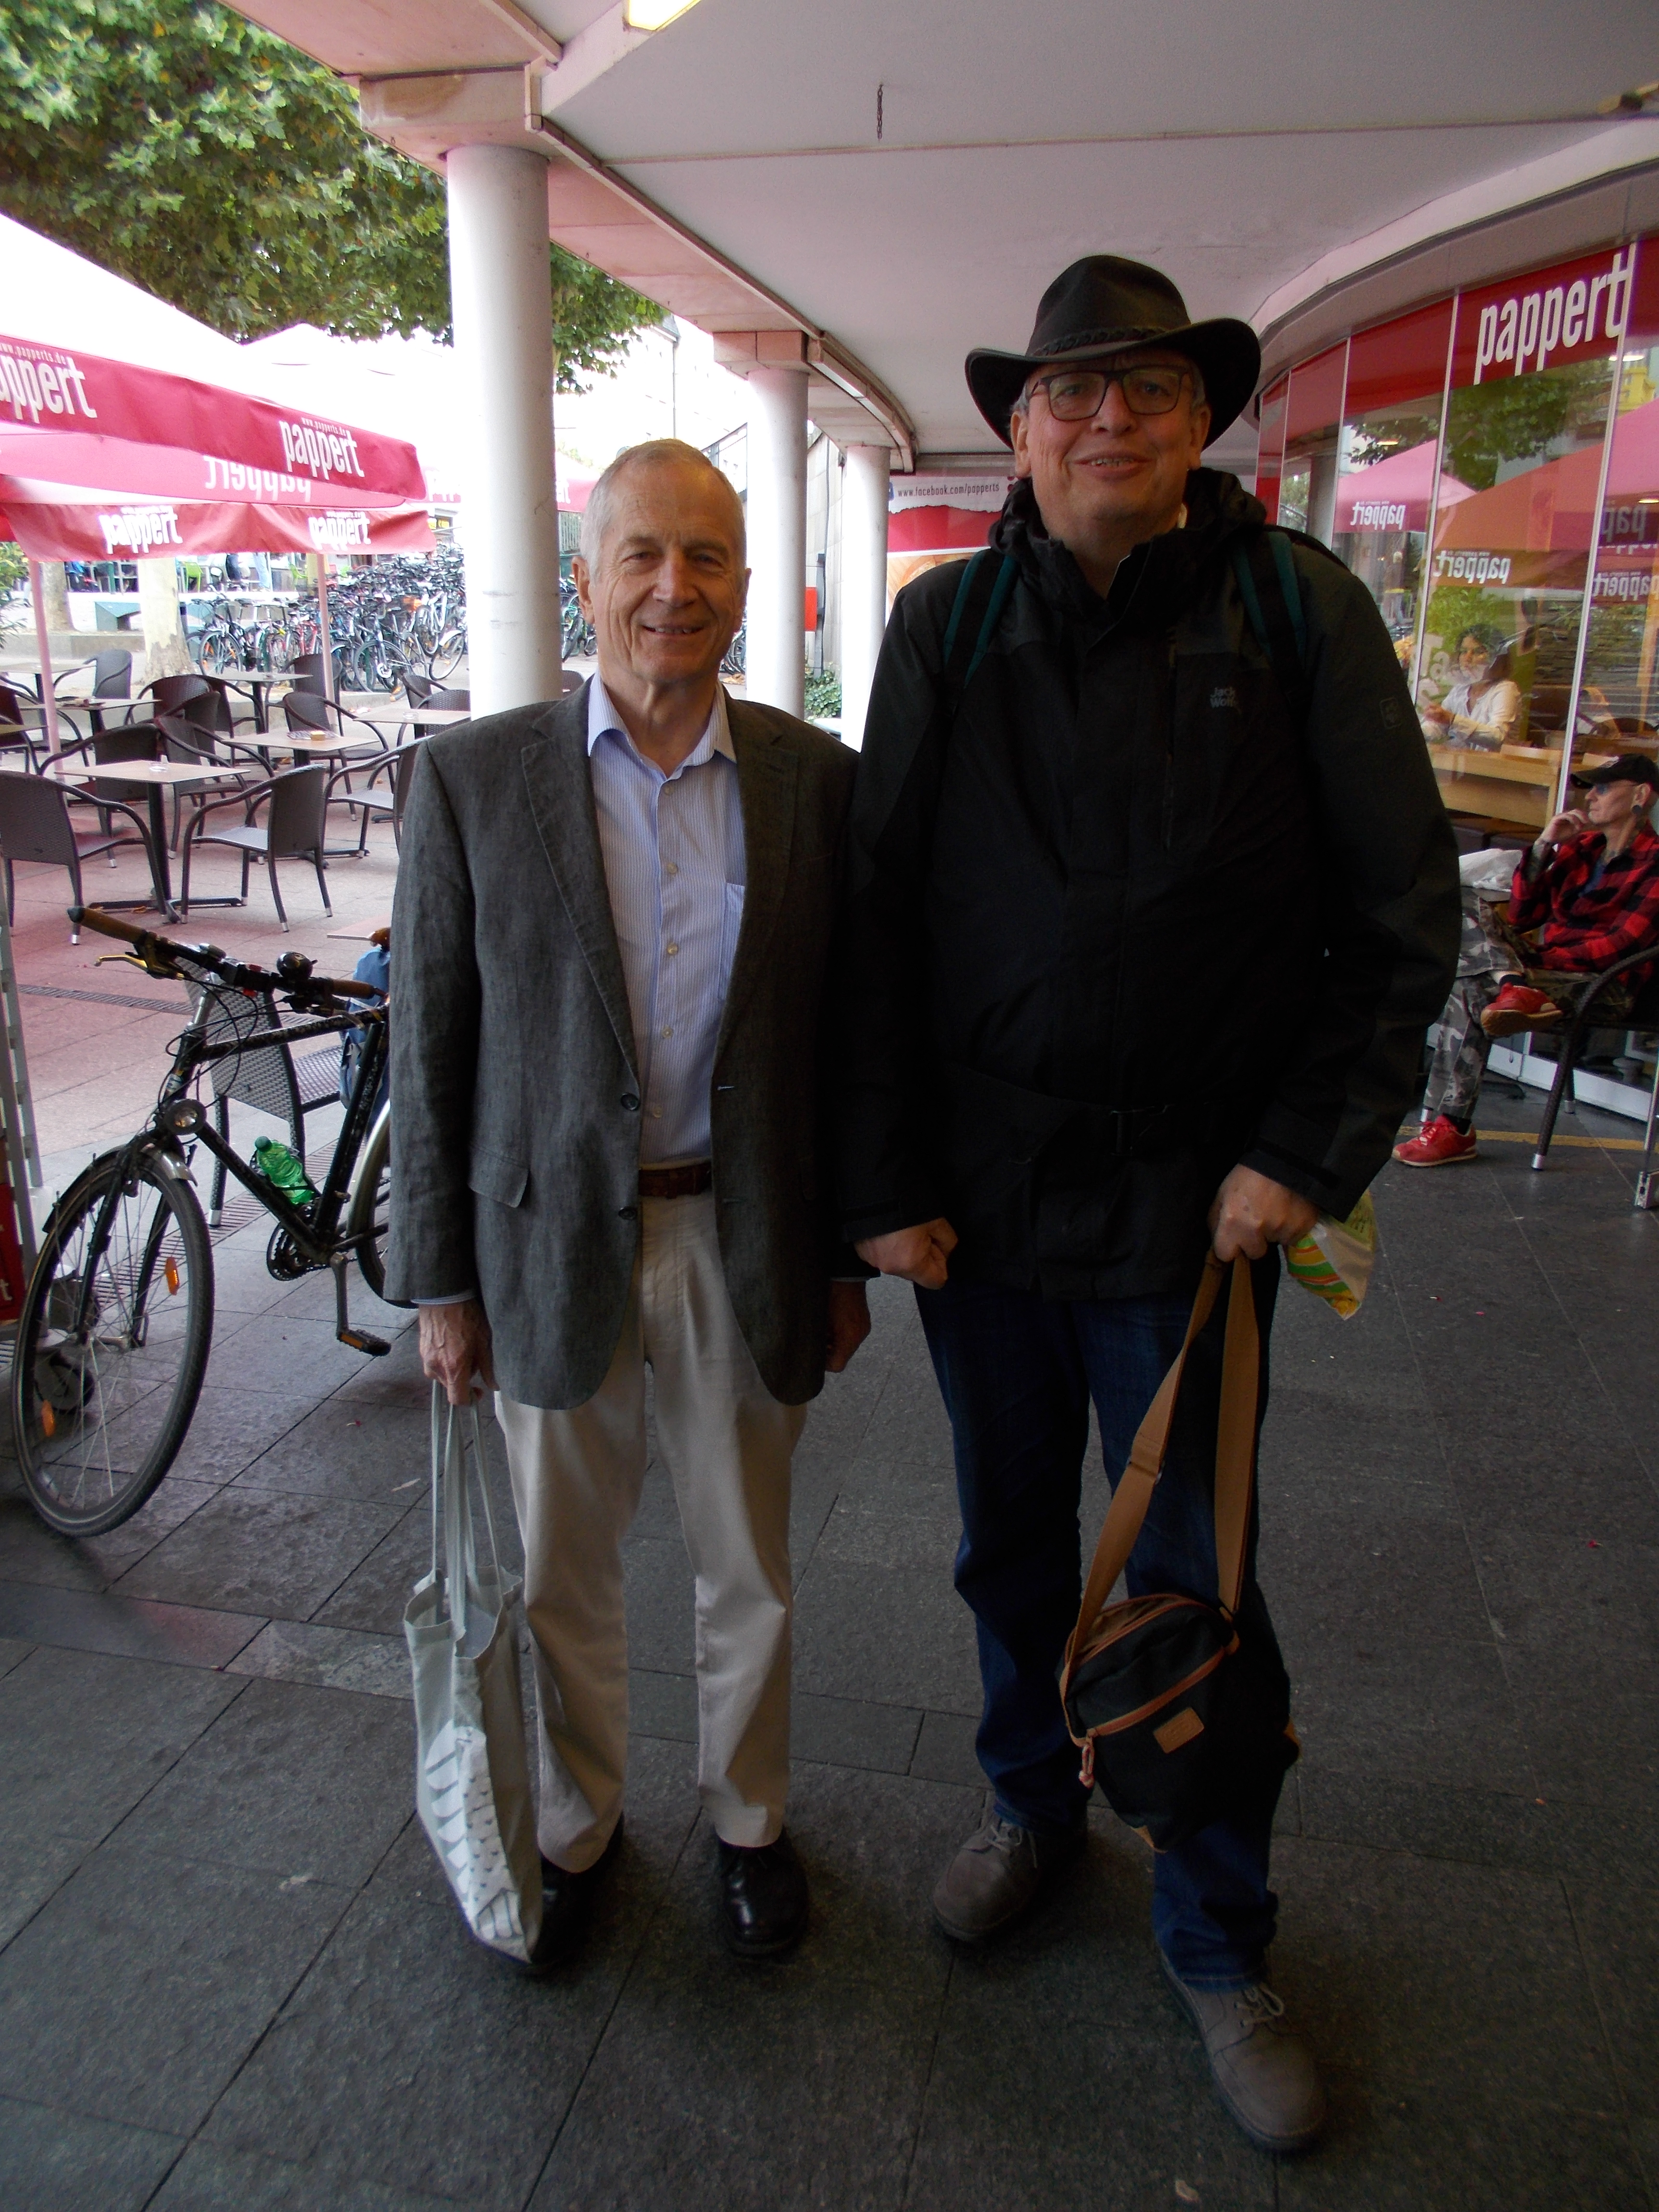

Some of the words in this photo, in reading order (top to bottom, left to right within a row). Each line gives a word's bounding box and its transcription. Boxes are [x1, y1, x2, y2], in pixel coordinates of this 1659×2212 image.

[1473, 252, 1628, 385] pappert
[0, 343, 67, 364] ww.papperts.de
[0, 354, 97, 423] appert
[279, 421, 365, 480] pappert
[898, 483, 1000, 497] www.facebook.com/papperts
[98, 505, 183, 554] pappert
[308, 511, 372, 551] pappert
